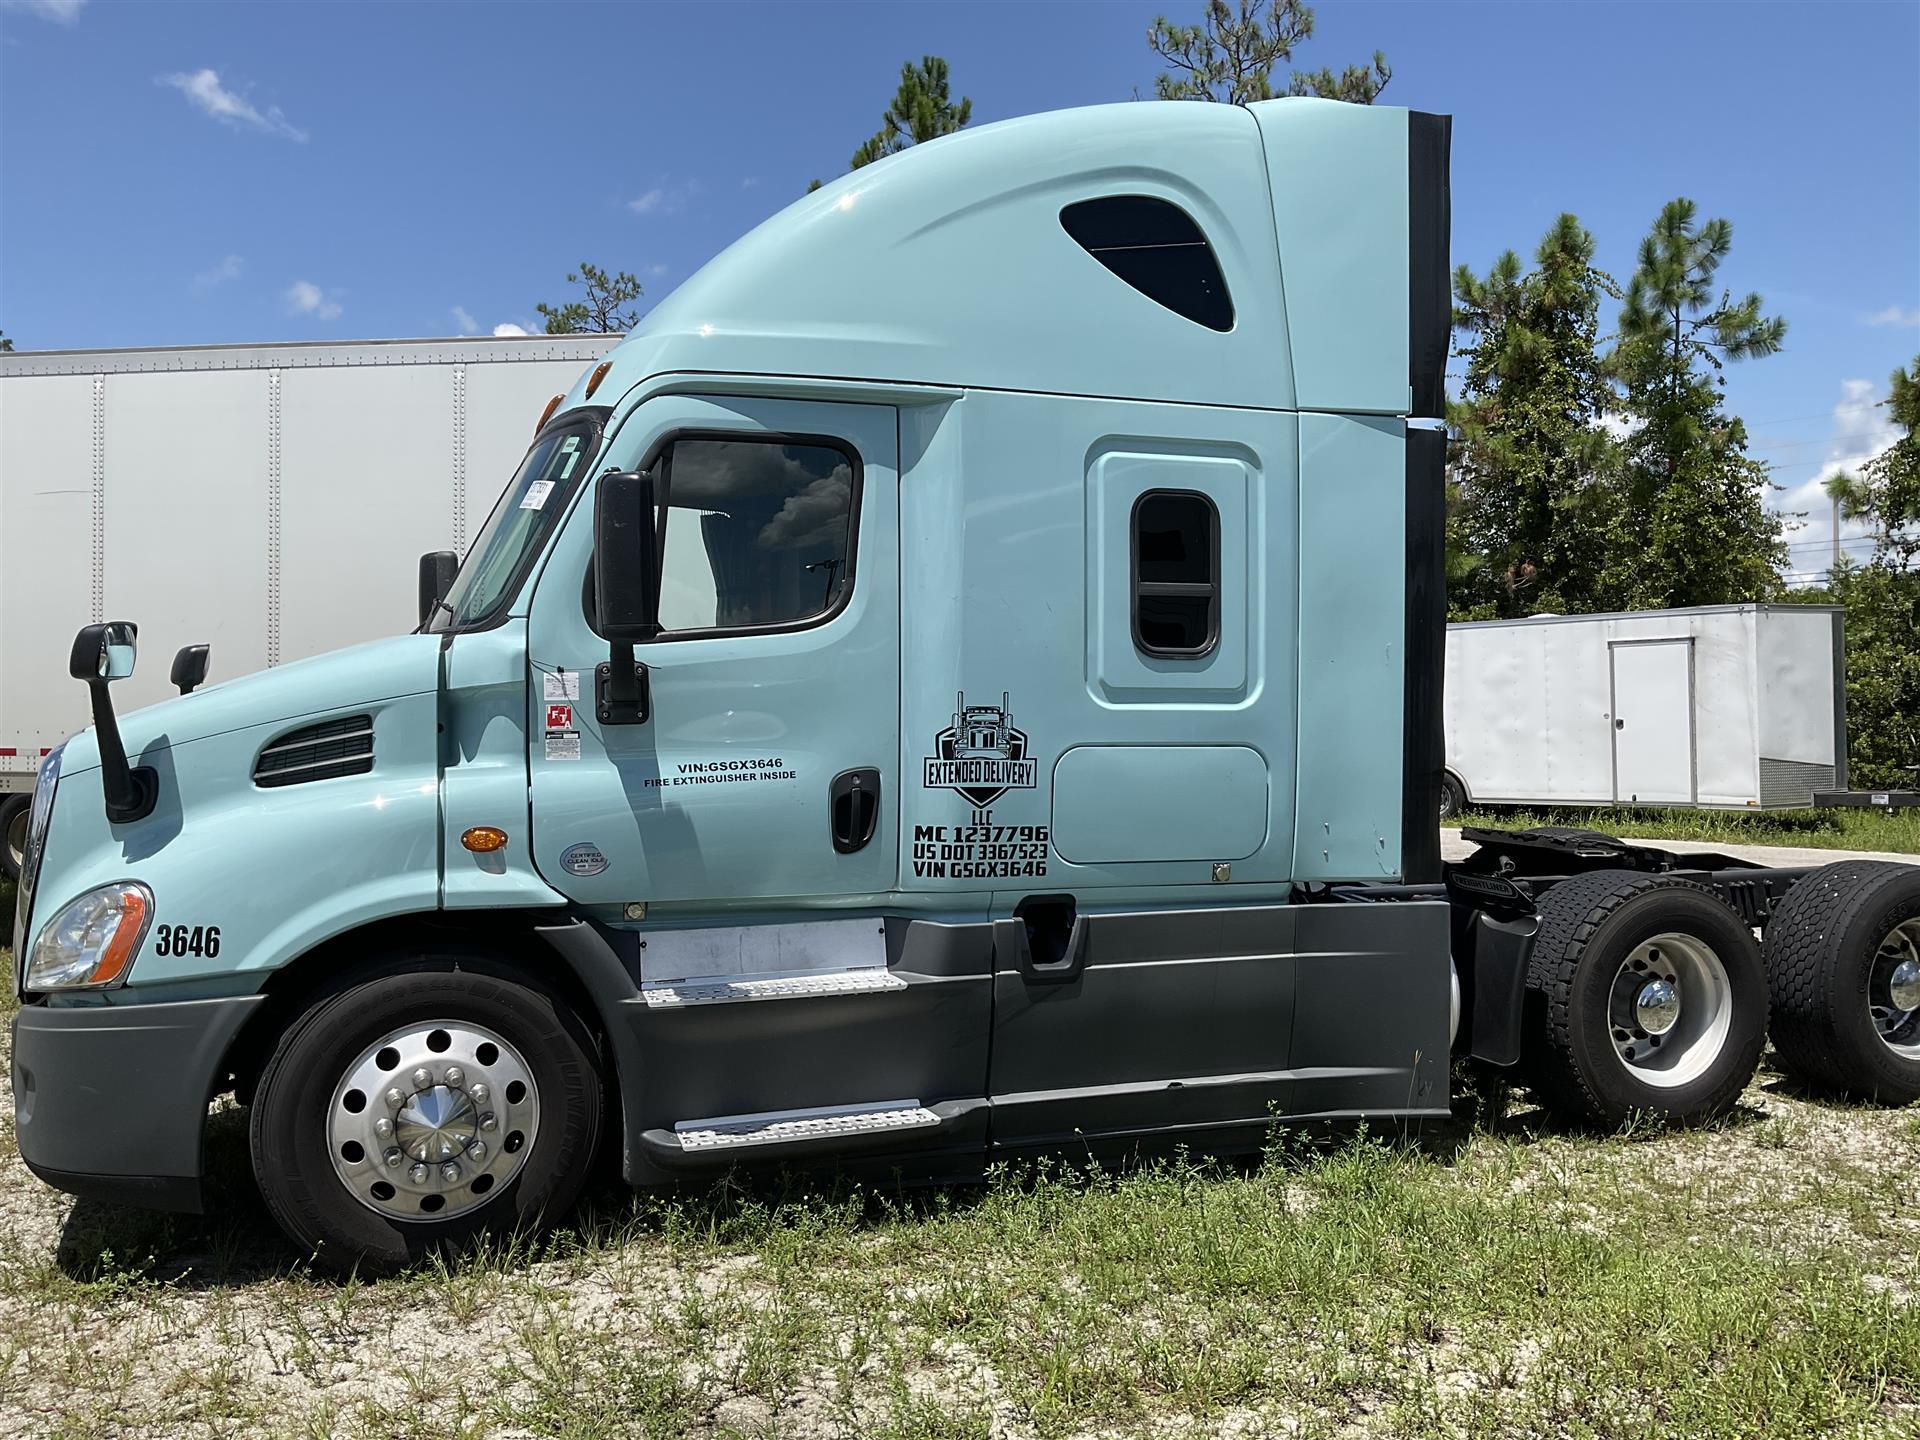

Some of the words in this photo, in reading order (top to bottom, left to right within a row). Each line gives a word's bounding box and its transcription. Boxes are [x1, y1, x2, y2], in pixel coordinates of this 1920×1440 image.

[547, 706, 572, 729] IFTA
[677, 758, 783, 774] VIN:GSGX3646
[928, 761, 980, 785] EXTENDED
[983, 761, 1032, 785] DELIVERY
[644, 778, 670, 788] FIRE
[673, 773, 757, 786] EXTINGUISHER
[760, 770, 797, 780] INSIDE
[971, 810, 993, 826] LLC
[914, 825, 947, 842] MC
[953, 826, 1048, 842] 1237796
[913, 843, 936, 859] US
[940, 844, 975, 860] DOT
[978, 843, 1048, 860] 3367523
[912, 861, 946, 877] VIN
[950, 861, 1046, 878] GSGX3646
[155, 924, 221, 958] 3646
